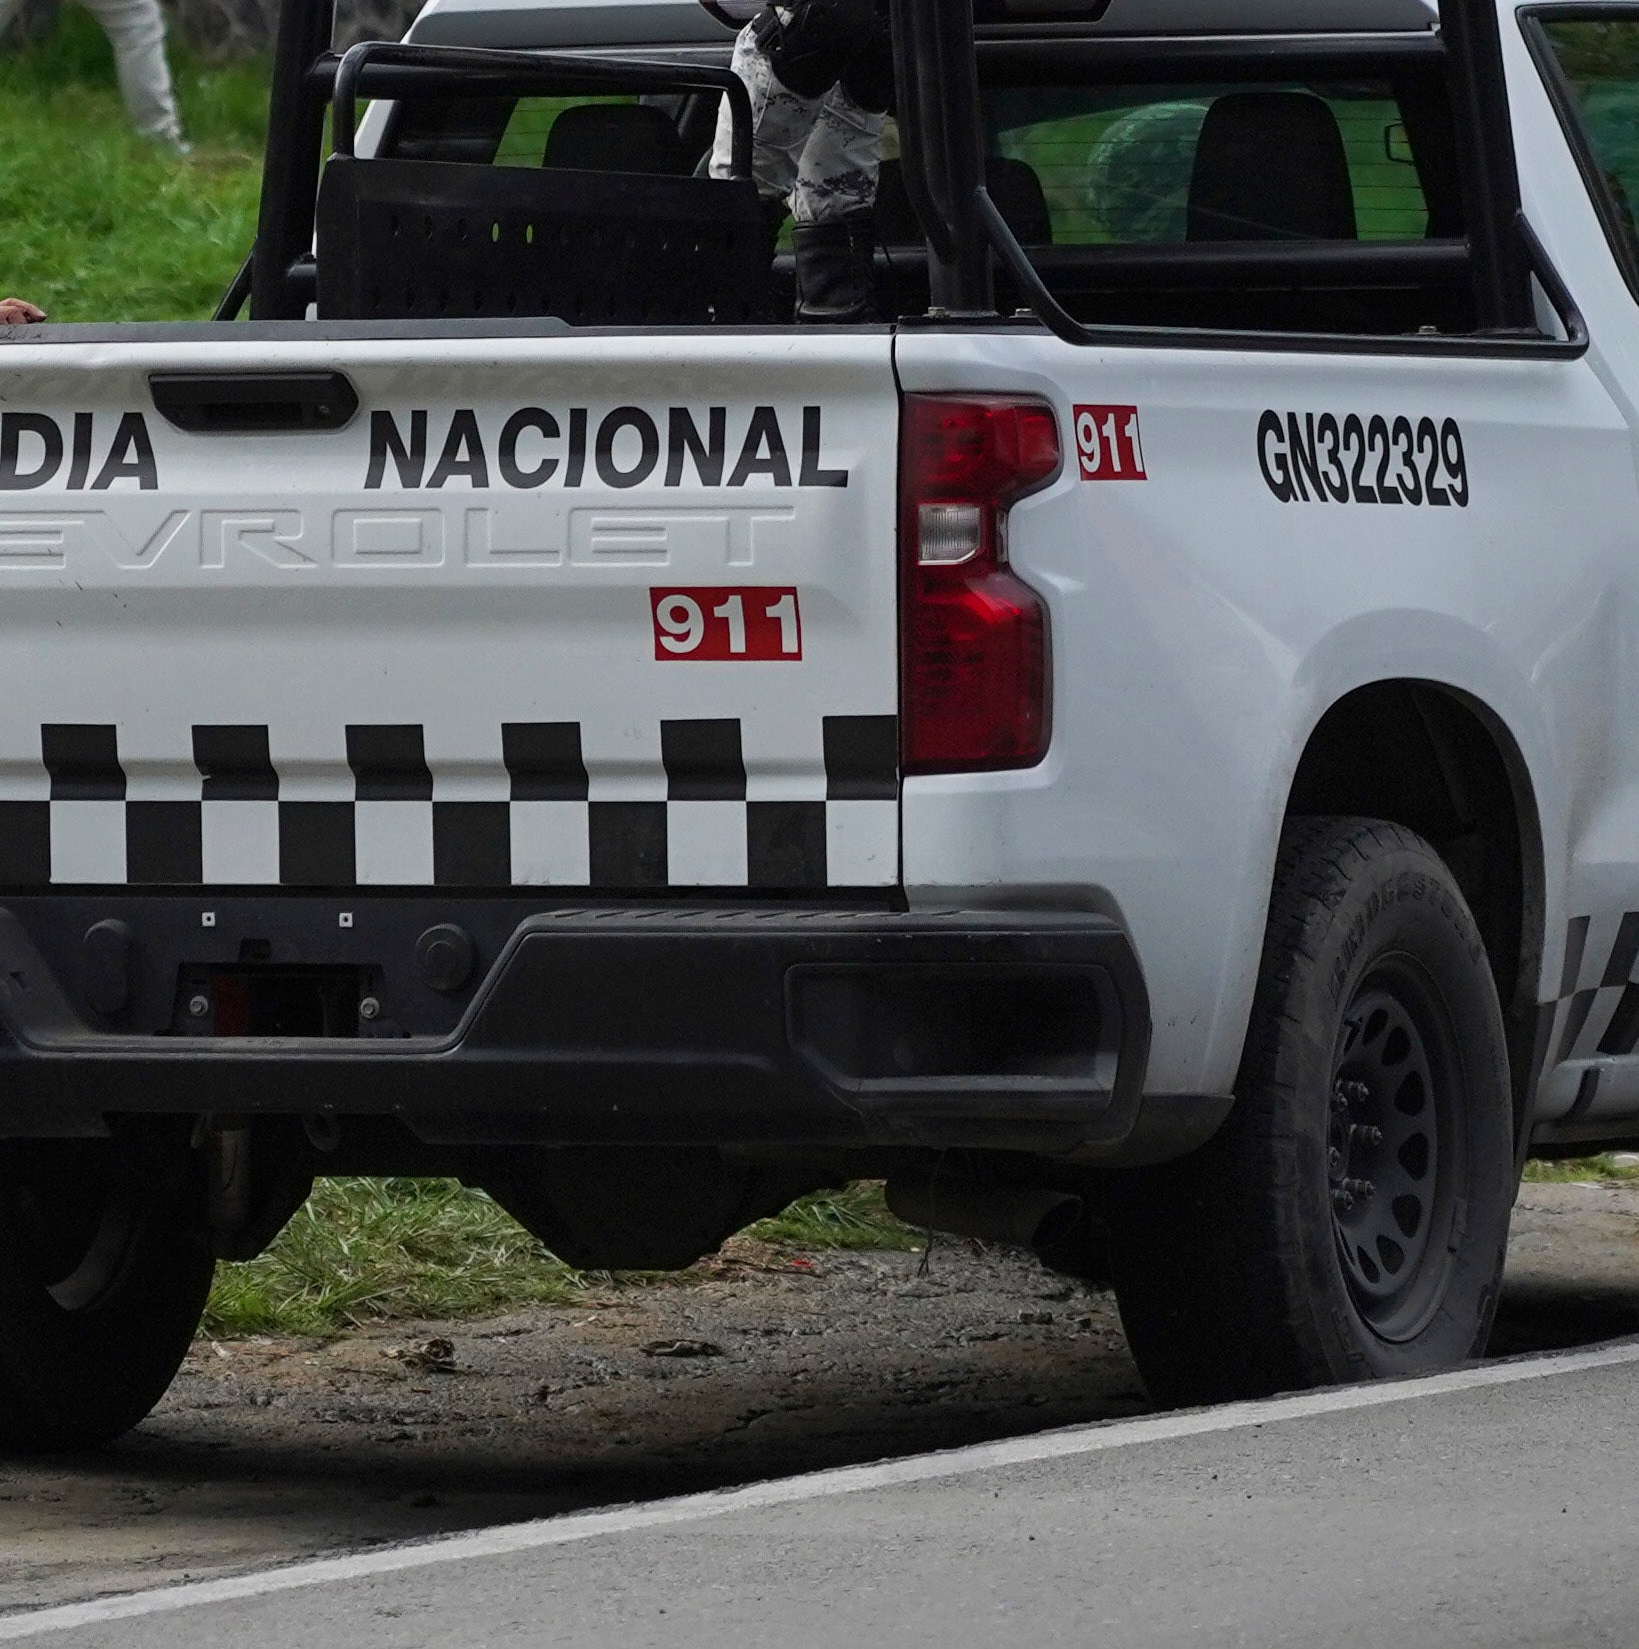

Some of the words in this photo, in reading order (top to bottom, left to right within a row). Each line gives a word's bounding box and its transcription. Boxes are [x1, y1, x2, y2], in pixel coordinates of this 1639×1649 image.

[363, 406, 850, 489] NACIONAL
[1076, 412, 1144, 473] 911
[1257, 409, 1469, 508] GN322329
[656, 594, 799, 654] 911
